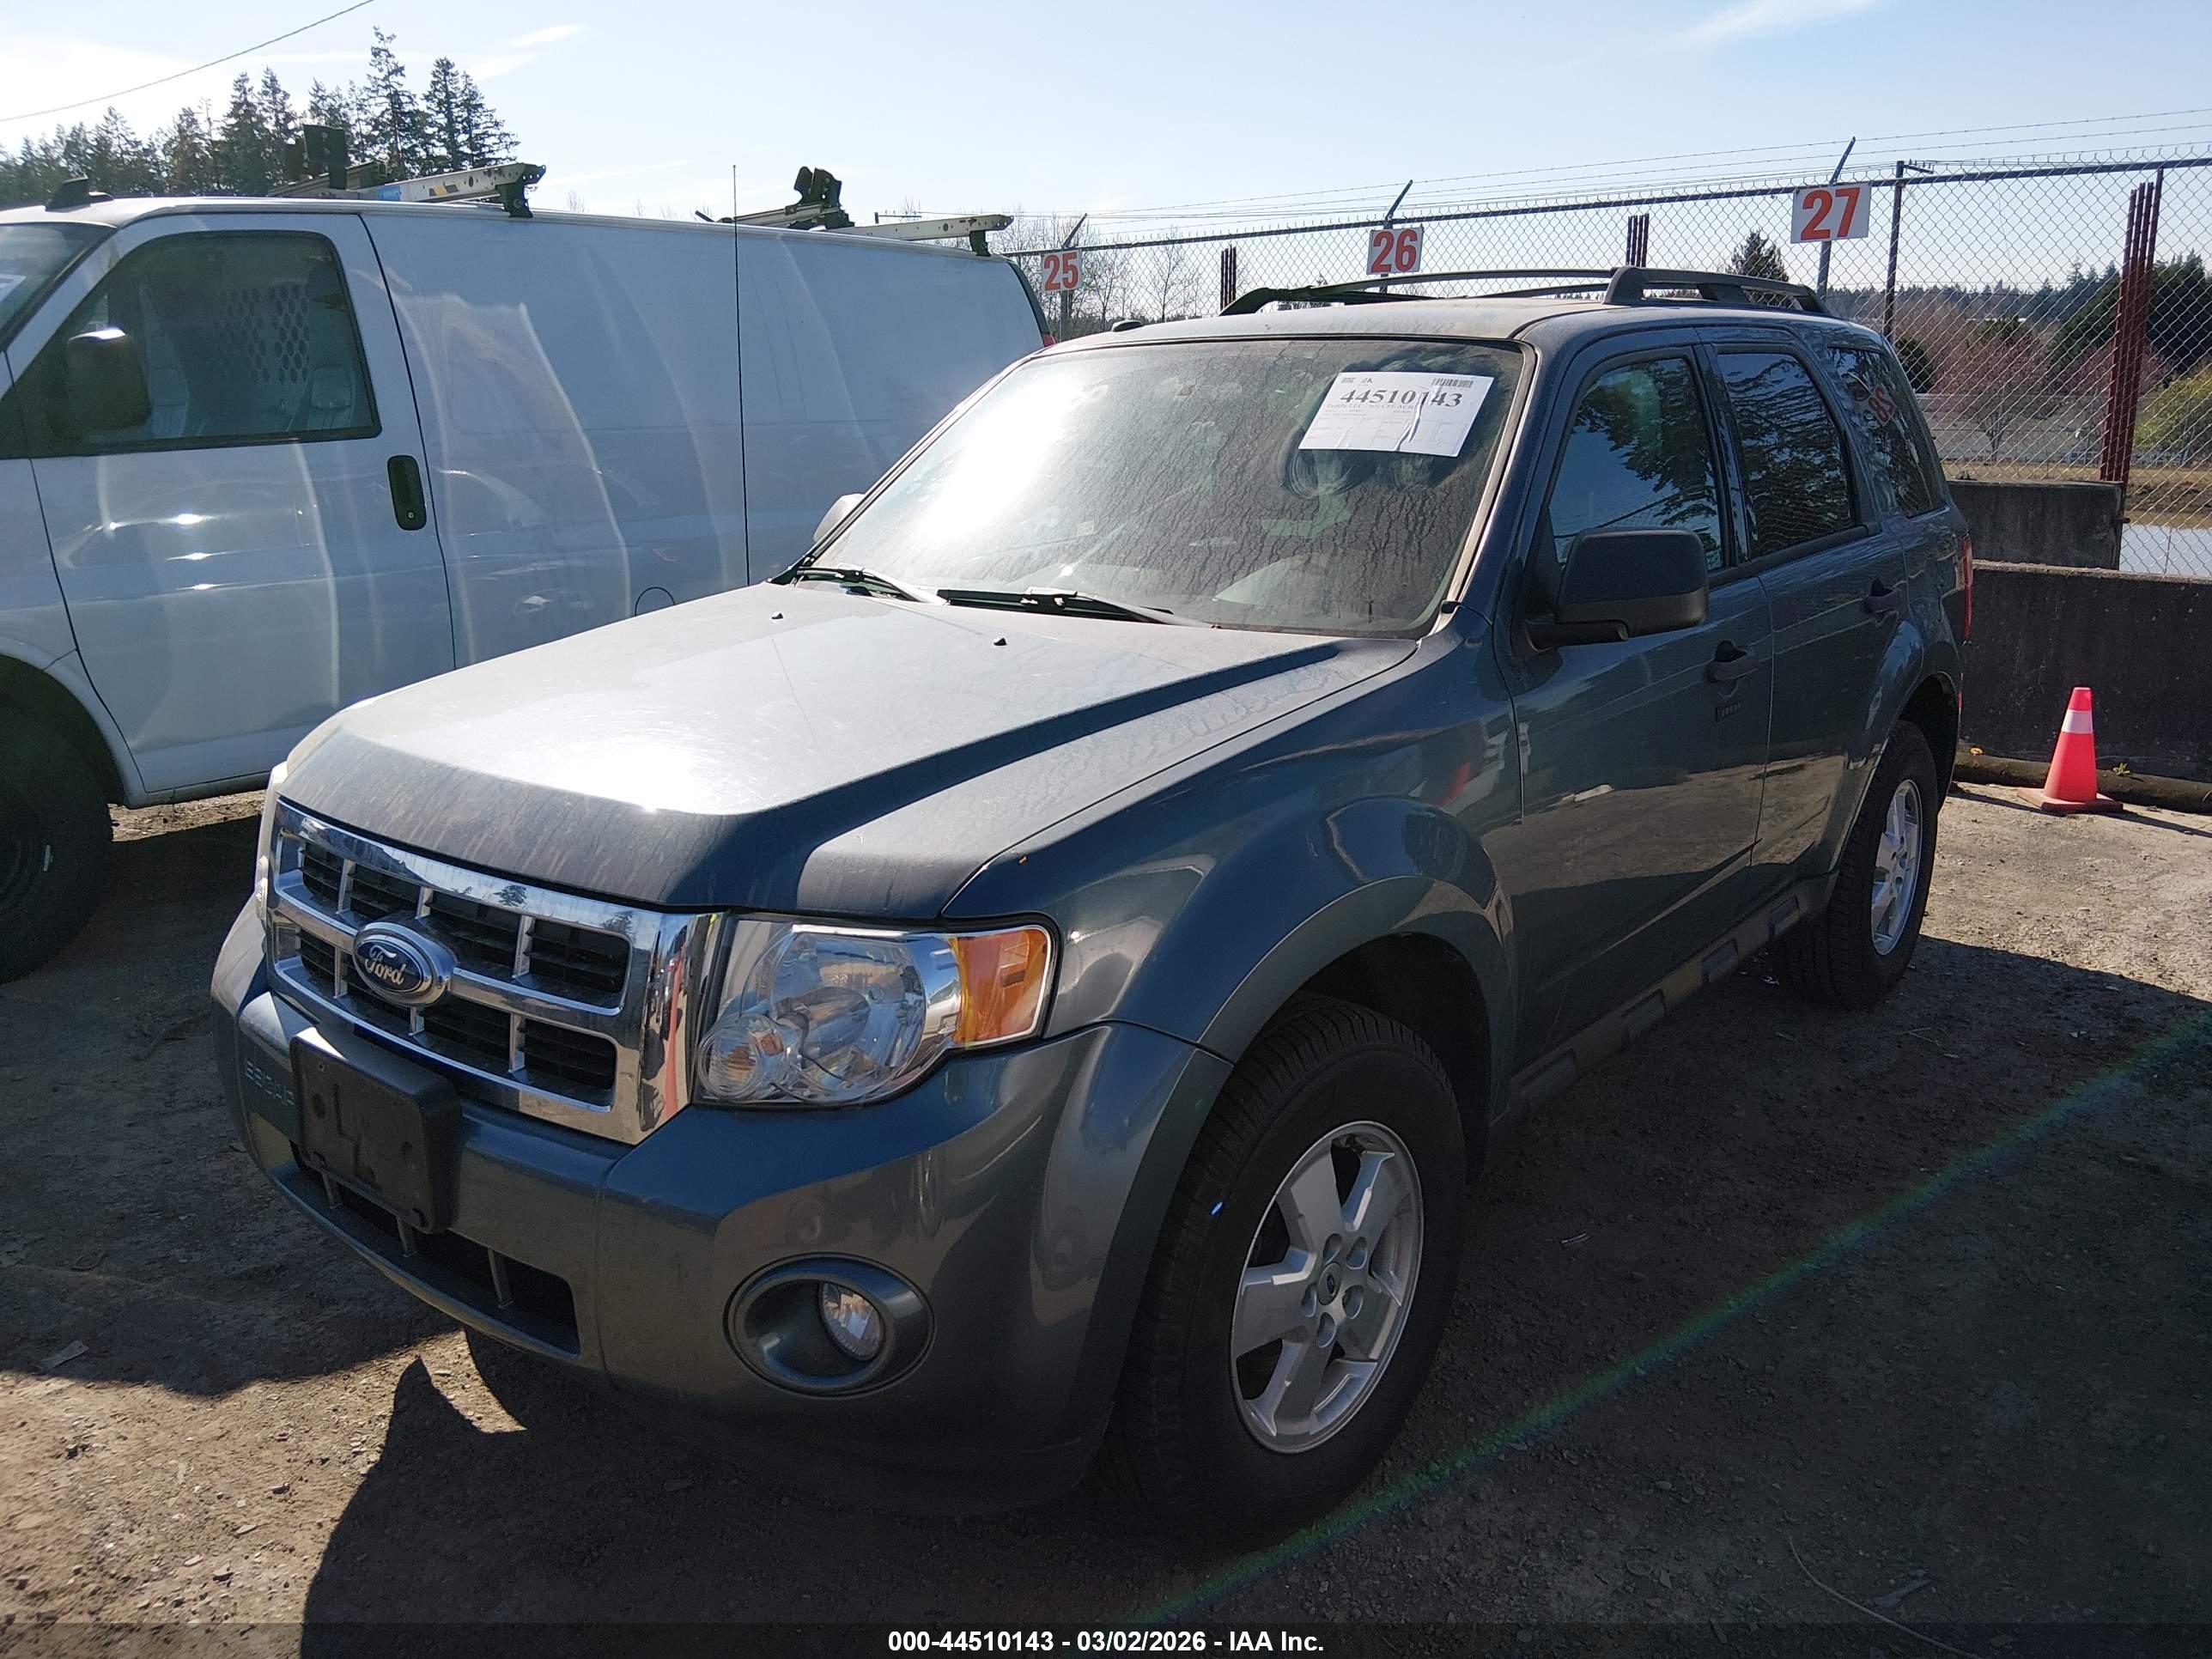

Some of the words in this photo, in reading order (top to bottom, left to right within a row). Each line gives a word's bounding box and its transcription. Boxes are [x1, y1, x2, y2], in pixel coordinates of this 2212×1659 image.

[1801, 187, 1860, 240] 27
[1043, 252, 1079, 291] 25
[1370, 228, 1418, 273] 26
[1340, 389, 1462, 407] 44510143
[365, 945, 407, 985] Ford
[245, 1060, 296, 1107] ESCAP
